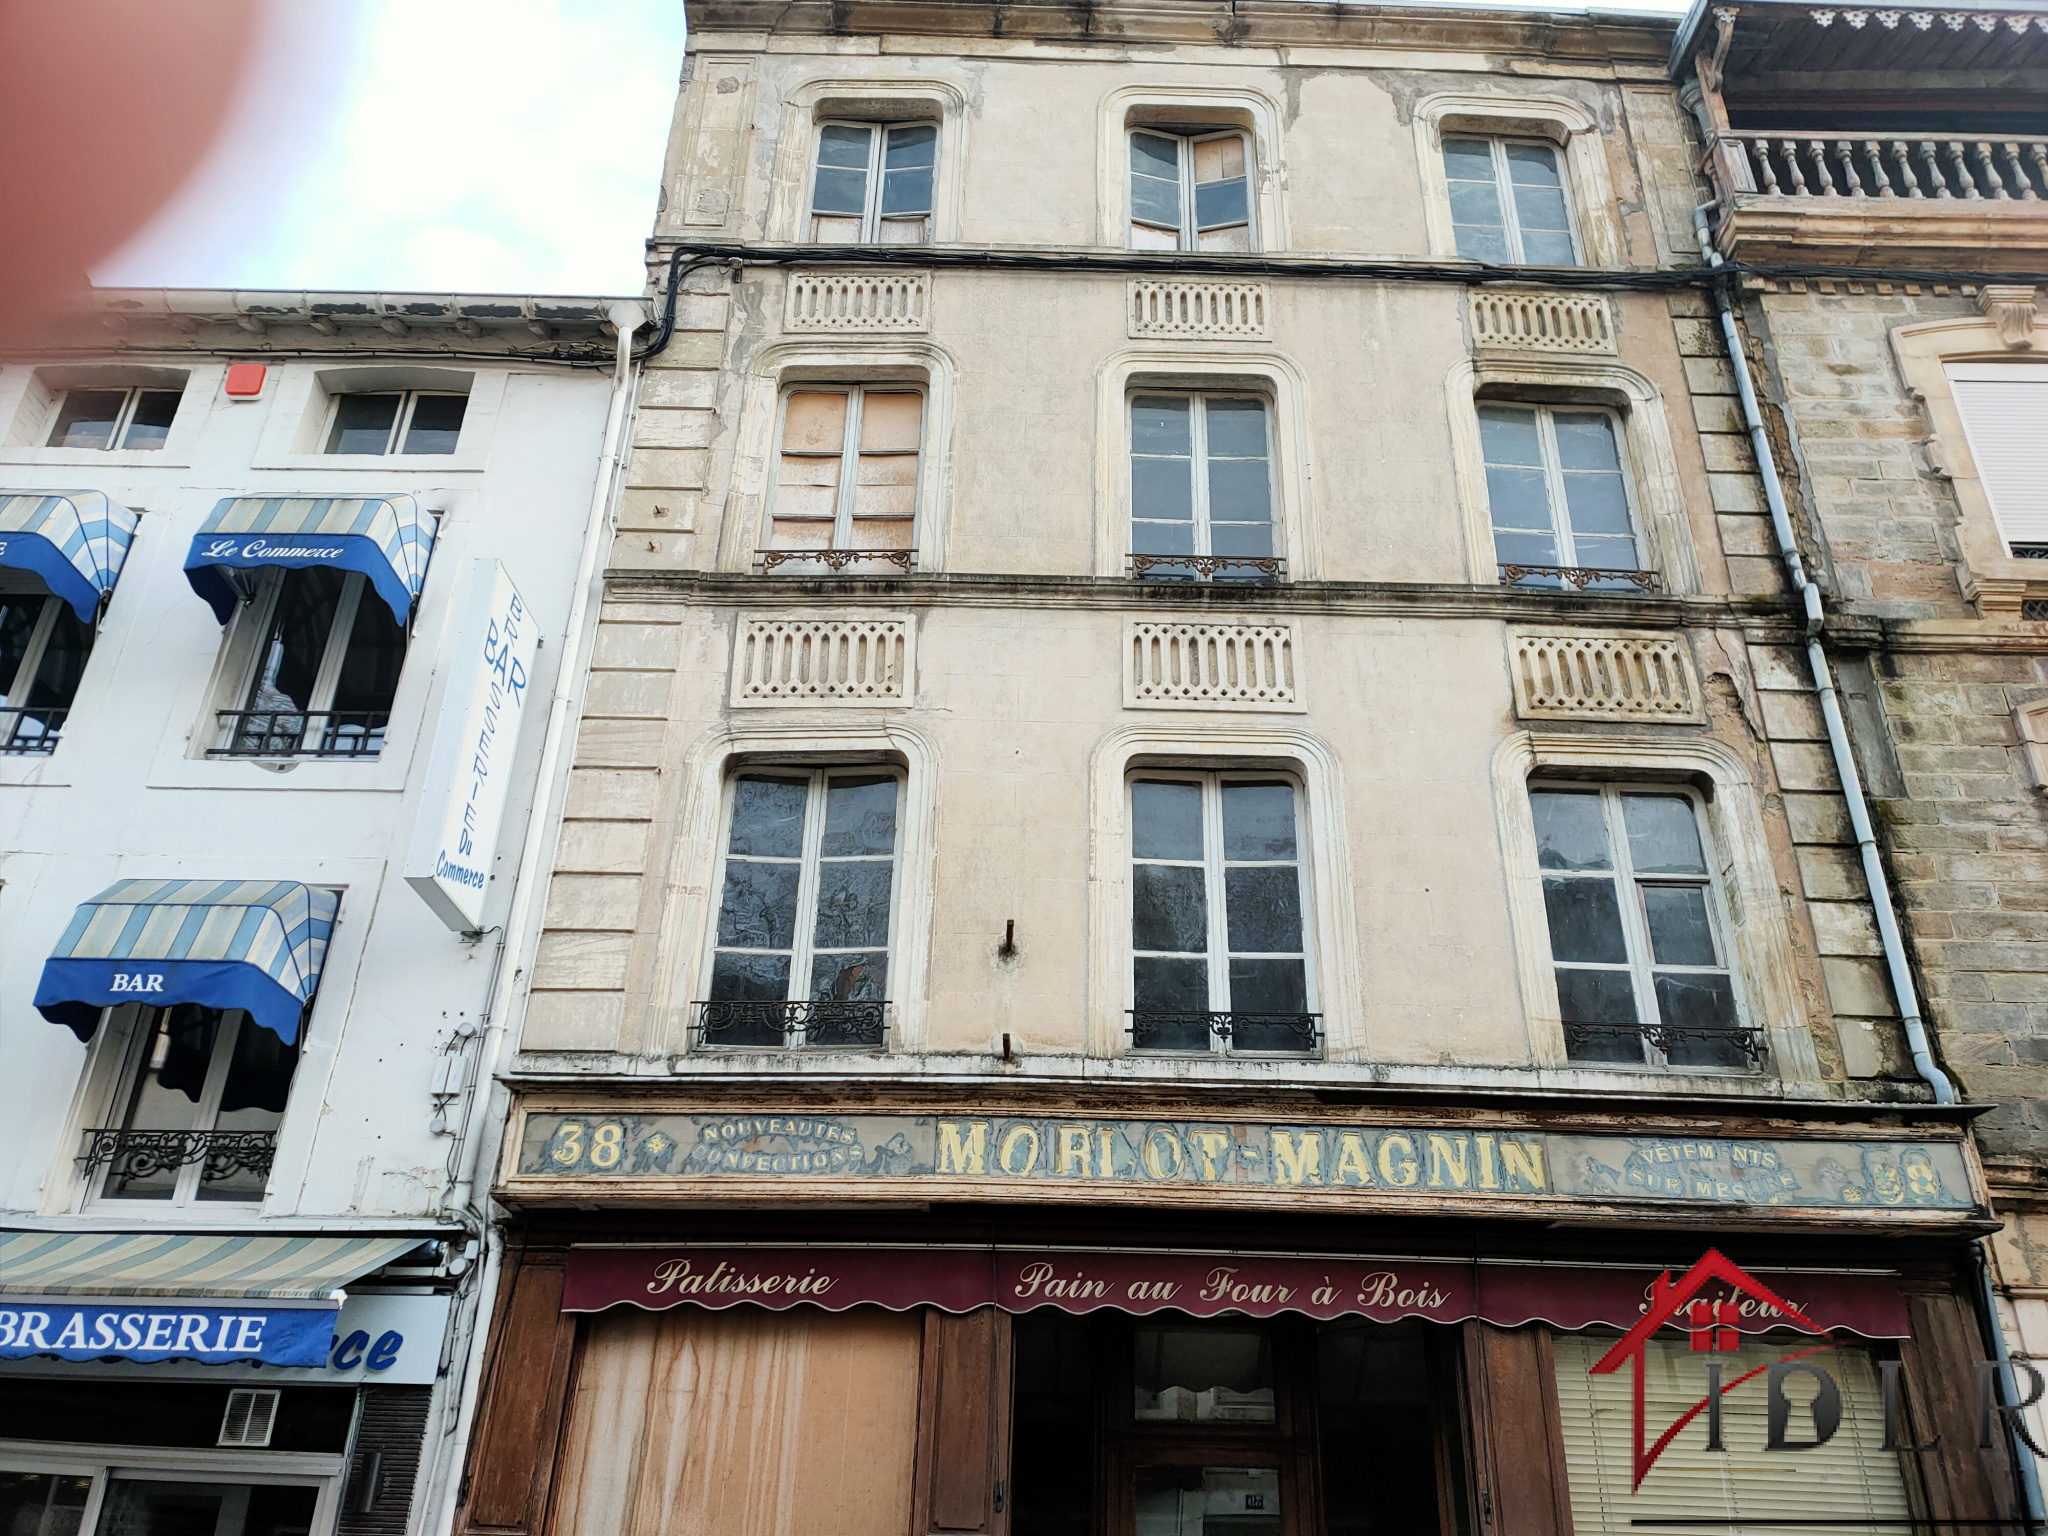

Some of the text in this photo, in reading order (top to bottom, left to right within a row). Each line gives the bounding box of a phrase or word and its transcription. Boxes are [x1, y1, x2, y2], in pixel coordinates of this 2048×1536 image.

[202, 539, 344, 558] Le Commerce
[484, 617, 526, 708] BAR
[458, 828, 473, 857] Du
[436, 849, 485, 889] Commerce
[109, 973, 164, 992] BAR
[553, 1123, 623, 1168] 38
[1631, 1168, 1680, 1191] SUR
[647, 1259, 839, 1294] Patisserie
[1015, 1262, 1451, 1308] Pain au Four à Bois
[0, 1310, 267, 1352] BRASSERIE
